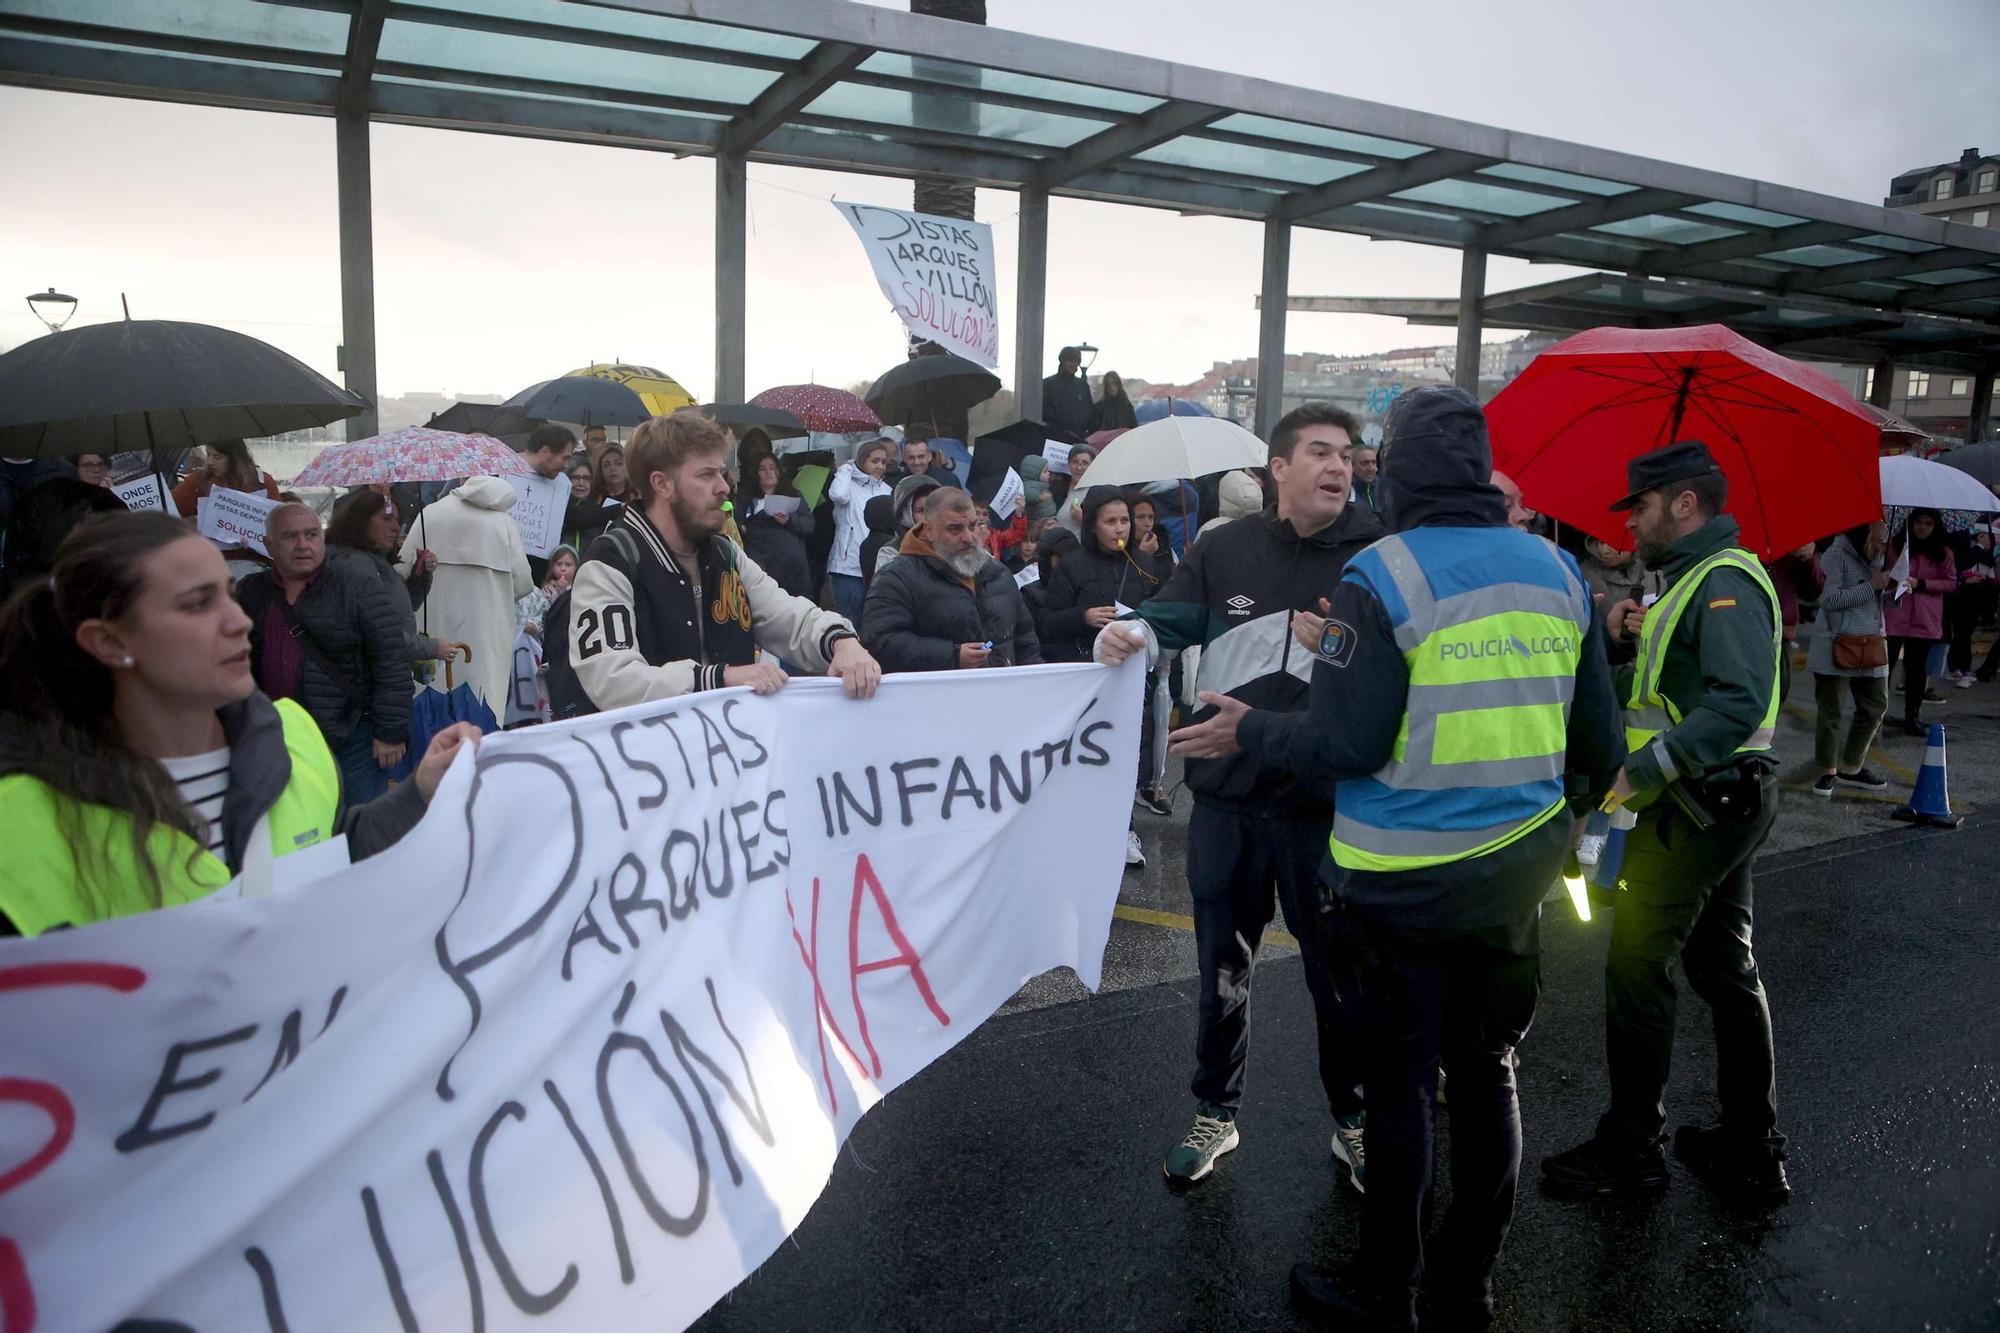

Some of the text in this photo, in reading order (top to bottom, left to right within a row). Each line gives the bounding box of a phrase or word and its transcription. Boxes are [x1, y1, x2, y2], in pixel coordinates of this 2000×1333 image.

[121, 484, 154, 501] ONDE
[214, 502, 239, 515] PISTAS
[217, 494, 251, 512] PARQUES
[1227, 608, 1251, 616] umbro
[576, 604, 634, 661] 20
[1440, 634, 1515, 661] POLICÍA
